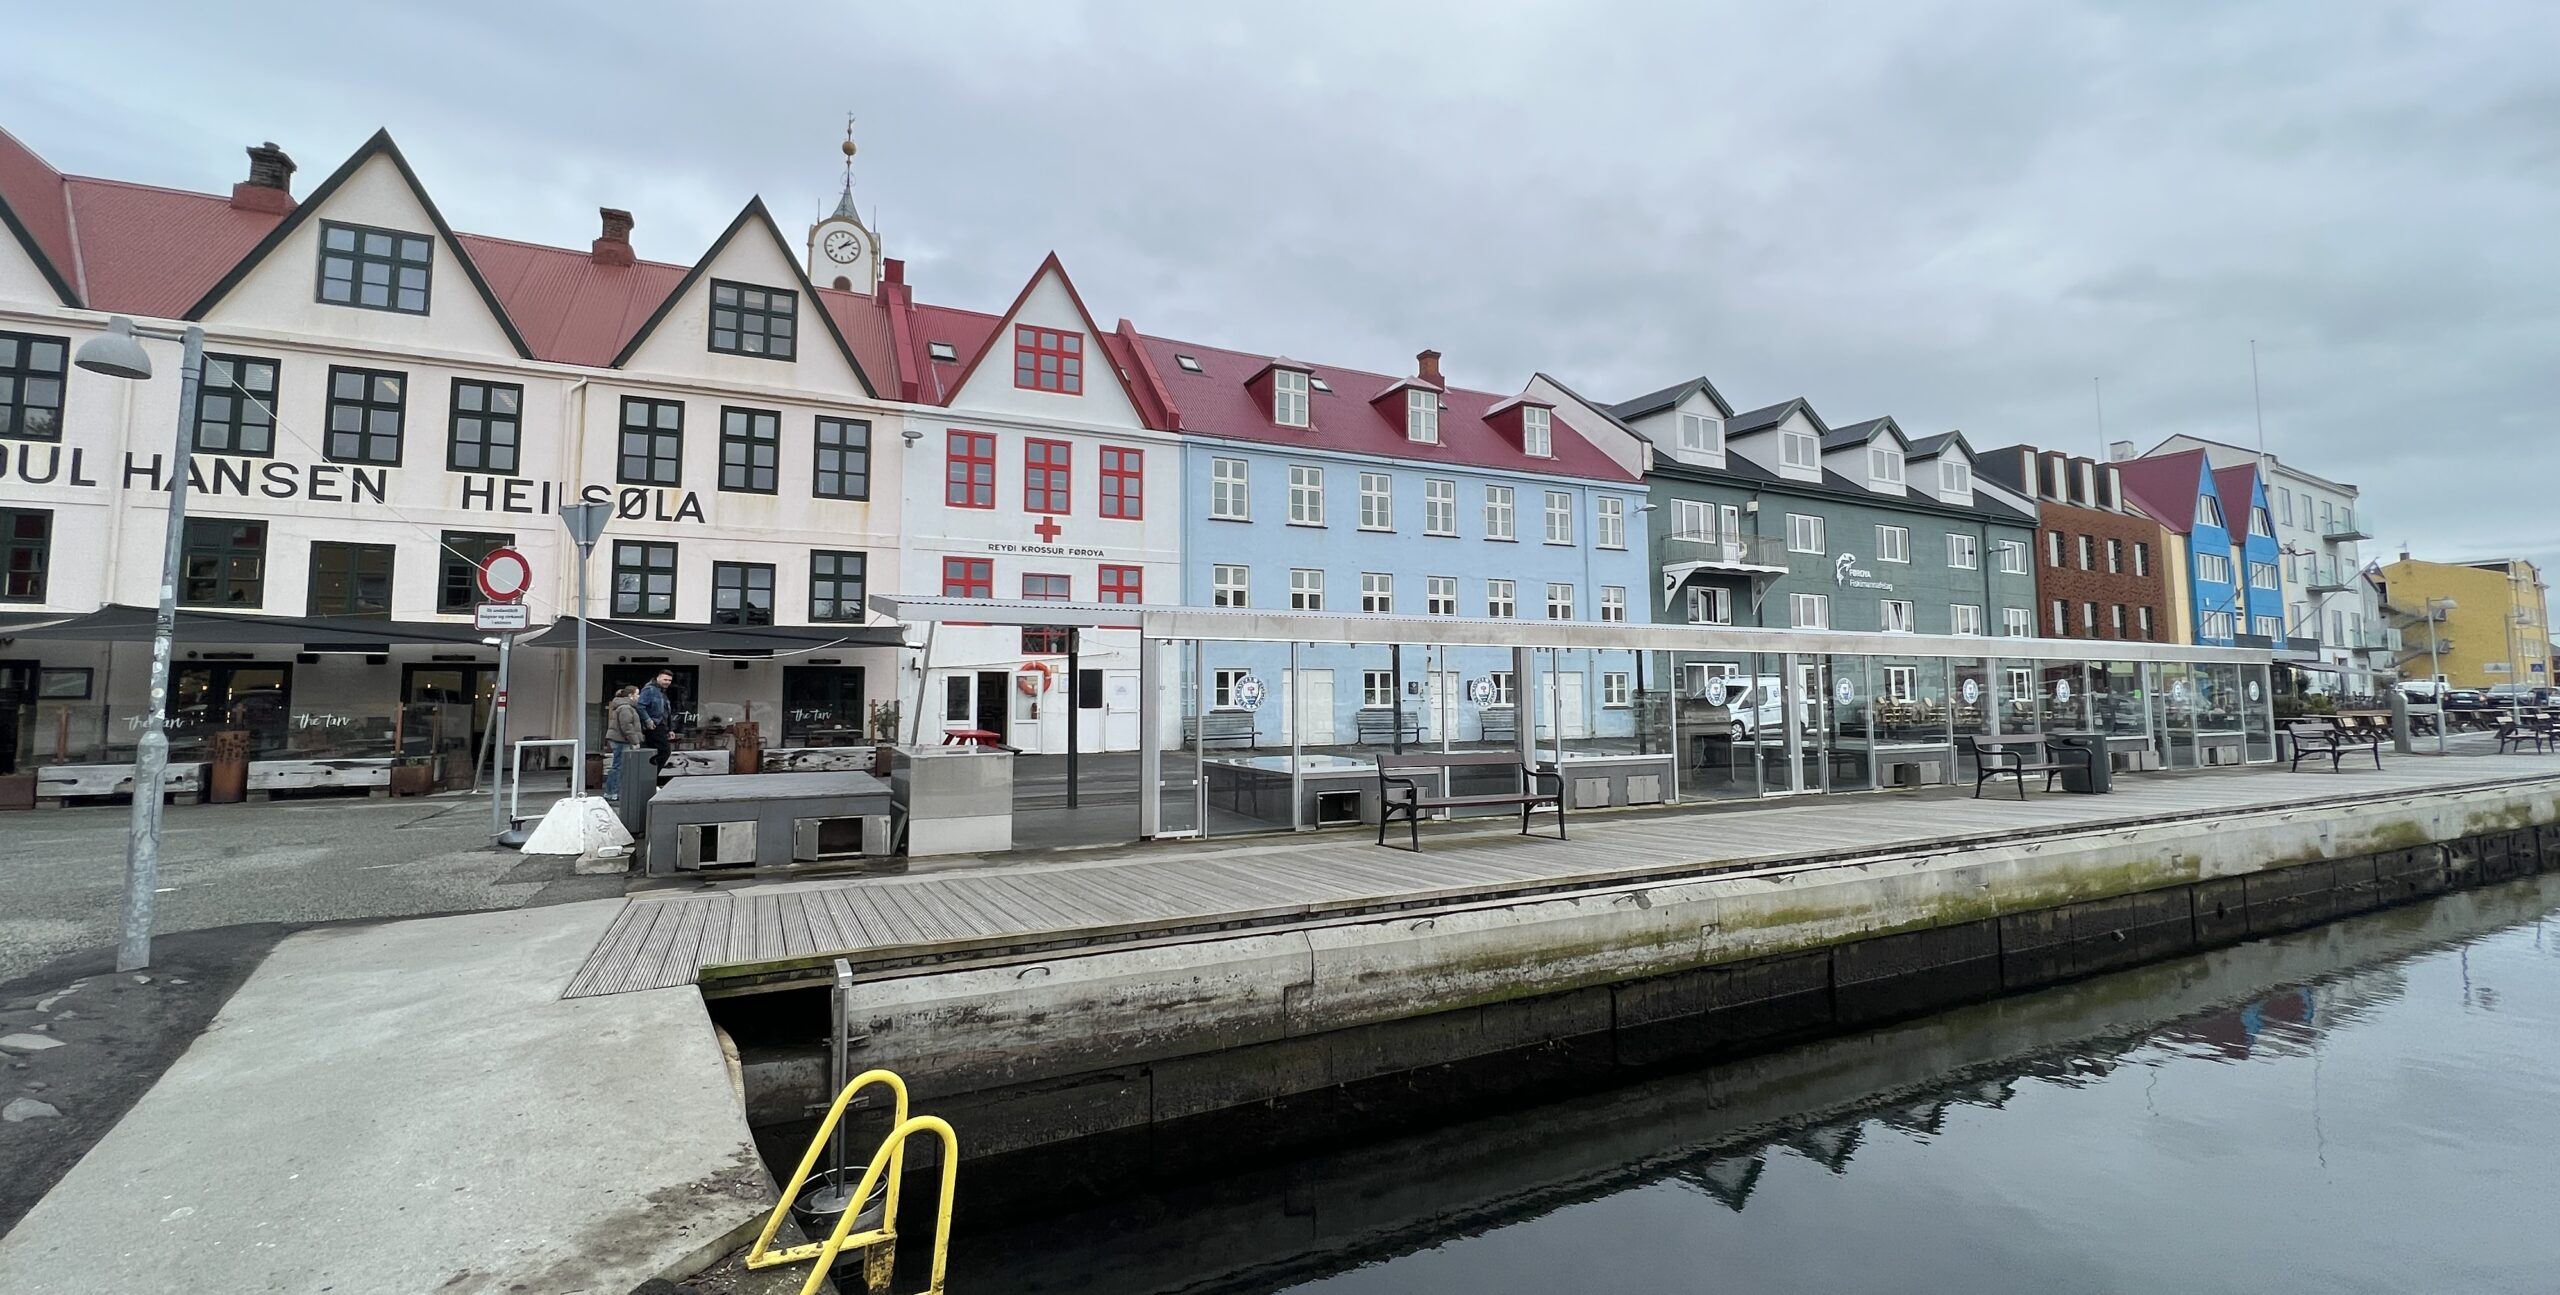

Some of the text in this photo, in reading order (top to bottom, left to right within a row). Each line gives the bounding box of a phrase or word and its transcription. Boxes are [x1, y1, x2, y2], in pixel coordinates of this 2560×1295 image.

[0, 444, 97, 487] UL
[462, 475, 706, 524] HEISØLA
[1021, 545, 1065, 555] KROSSUR
[1068, 548, 1105, 557] FØROYA
